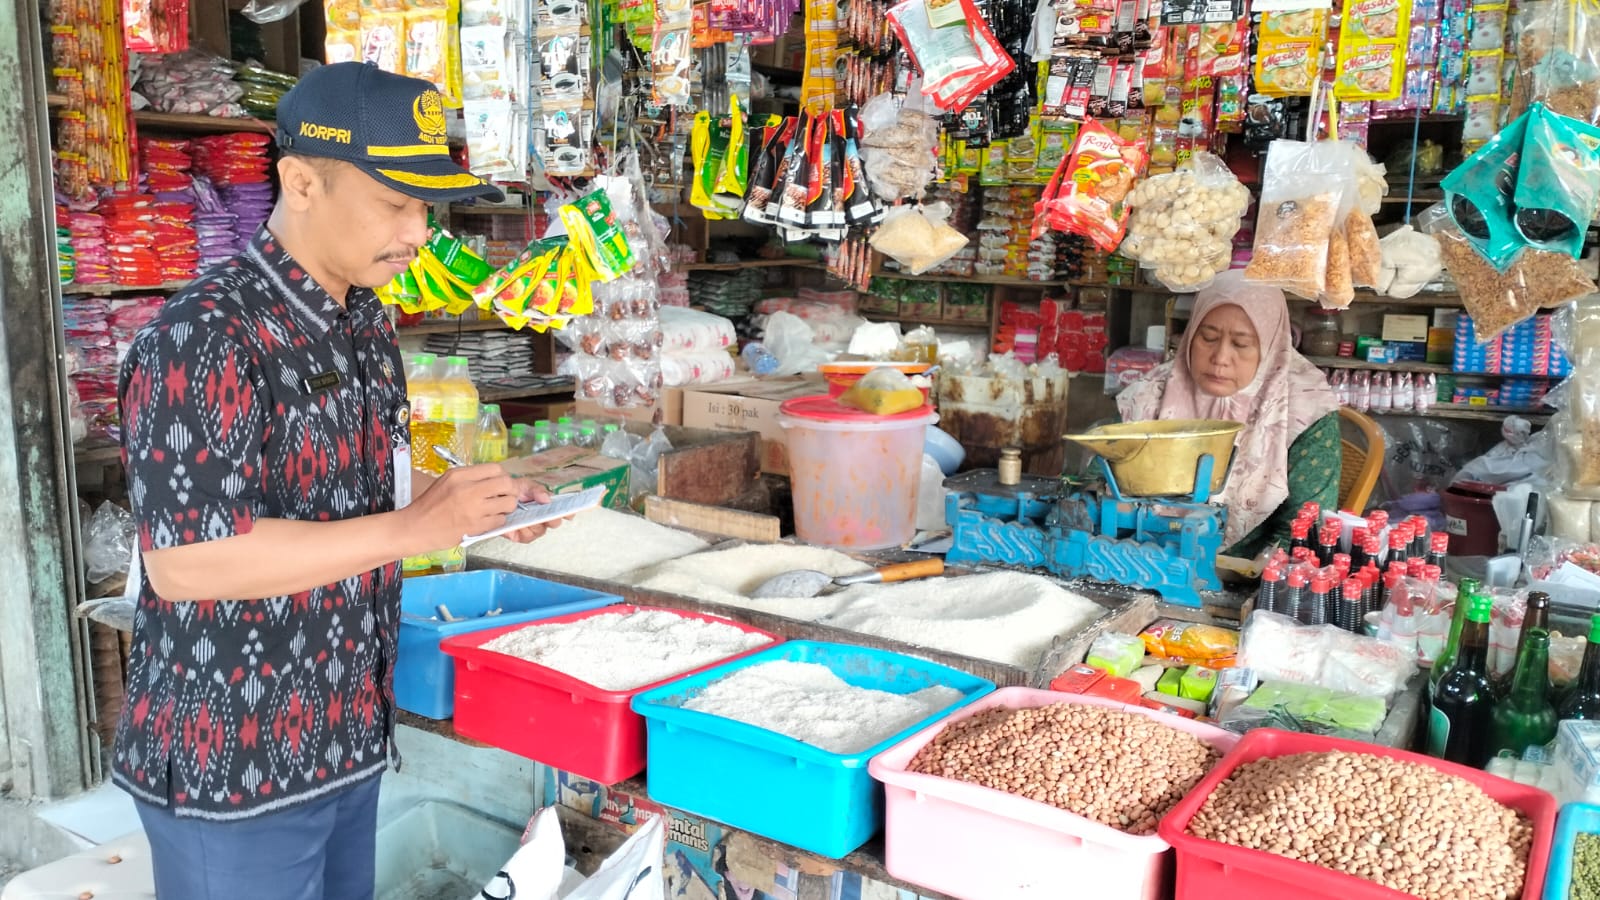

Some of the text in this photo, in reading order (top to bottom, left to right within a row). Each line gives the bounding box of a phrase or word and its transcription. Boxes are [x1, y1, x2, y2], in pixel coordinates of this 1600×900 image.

[1344, 51, 1390, 69] Masako
[962, 111, 983, 121] TOP
[300, 121, 352, 145] KORPRI
[708, 402, 720, 413] Isi
[728, 405, 740, 416] 30
[742, 407, 759, 419] pak
